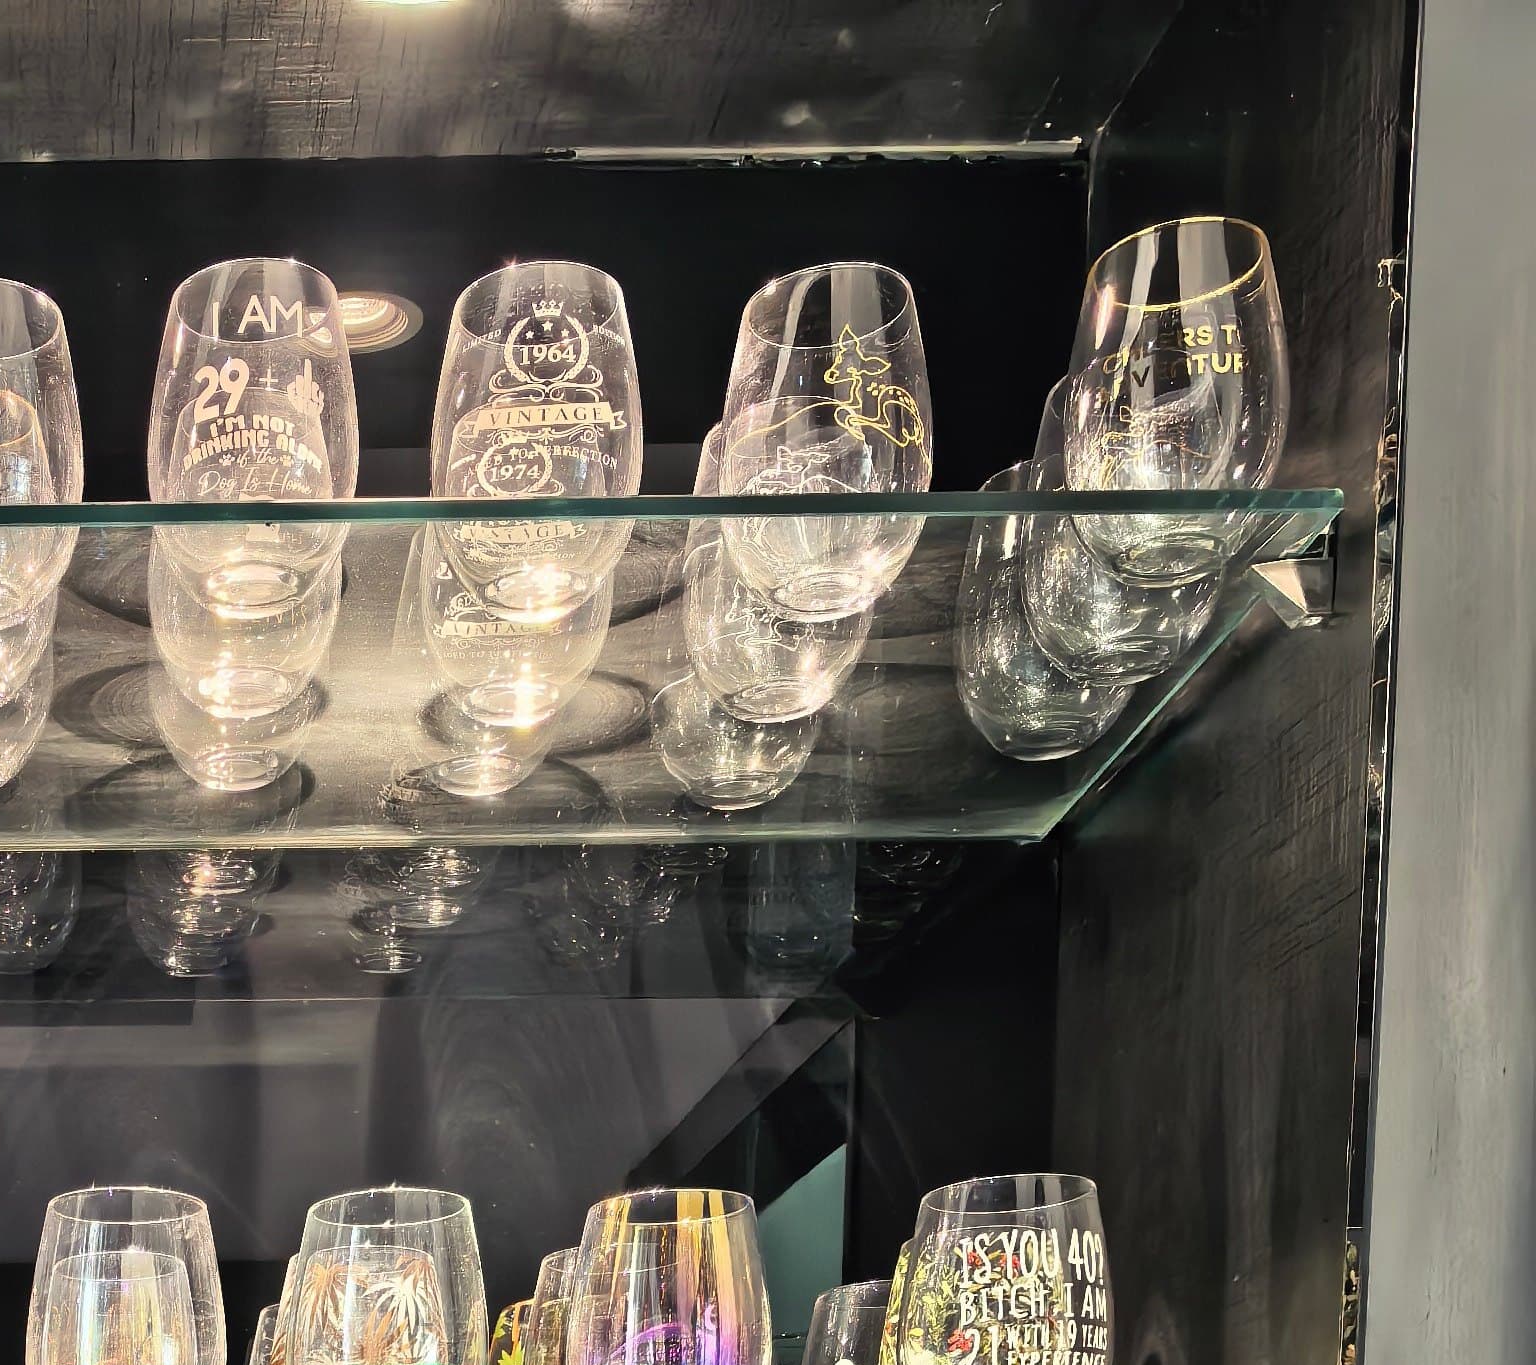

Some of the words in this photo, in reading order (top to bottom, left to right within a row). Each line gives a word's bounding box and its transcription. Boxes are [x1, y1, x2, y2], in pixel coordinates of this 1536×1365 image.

[212, 301, 220, 337] I
[237, 294, 303, 337] AM
[519, 344, 577, 366] 1964
[193, 358, 250, 424] 29
[253, 415, 296, 437] NOT
[489, 406, 605, 426] VINTAGE
[183, 429, 270, 472] DRINKING
[255, 447, 280, 466] the
[198, 470, 238, 498] Dog
[490, 464, 541, 482] 1974
[958, 1231, 992, 1289] IS
[991, 1228, 1061, 1280] YOU
[1068, 1228, 1105, 1286] 40?
[1081, 1284, 1107, 1322] AM
[1005, 1322, 1050, 1350] WITH
[1057, 1319, 1078, 1349] 19
[1081, 1324, 1108, 1351] YEARS
